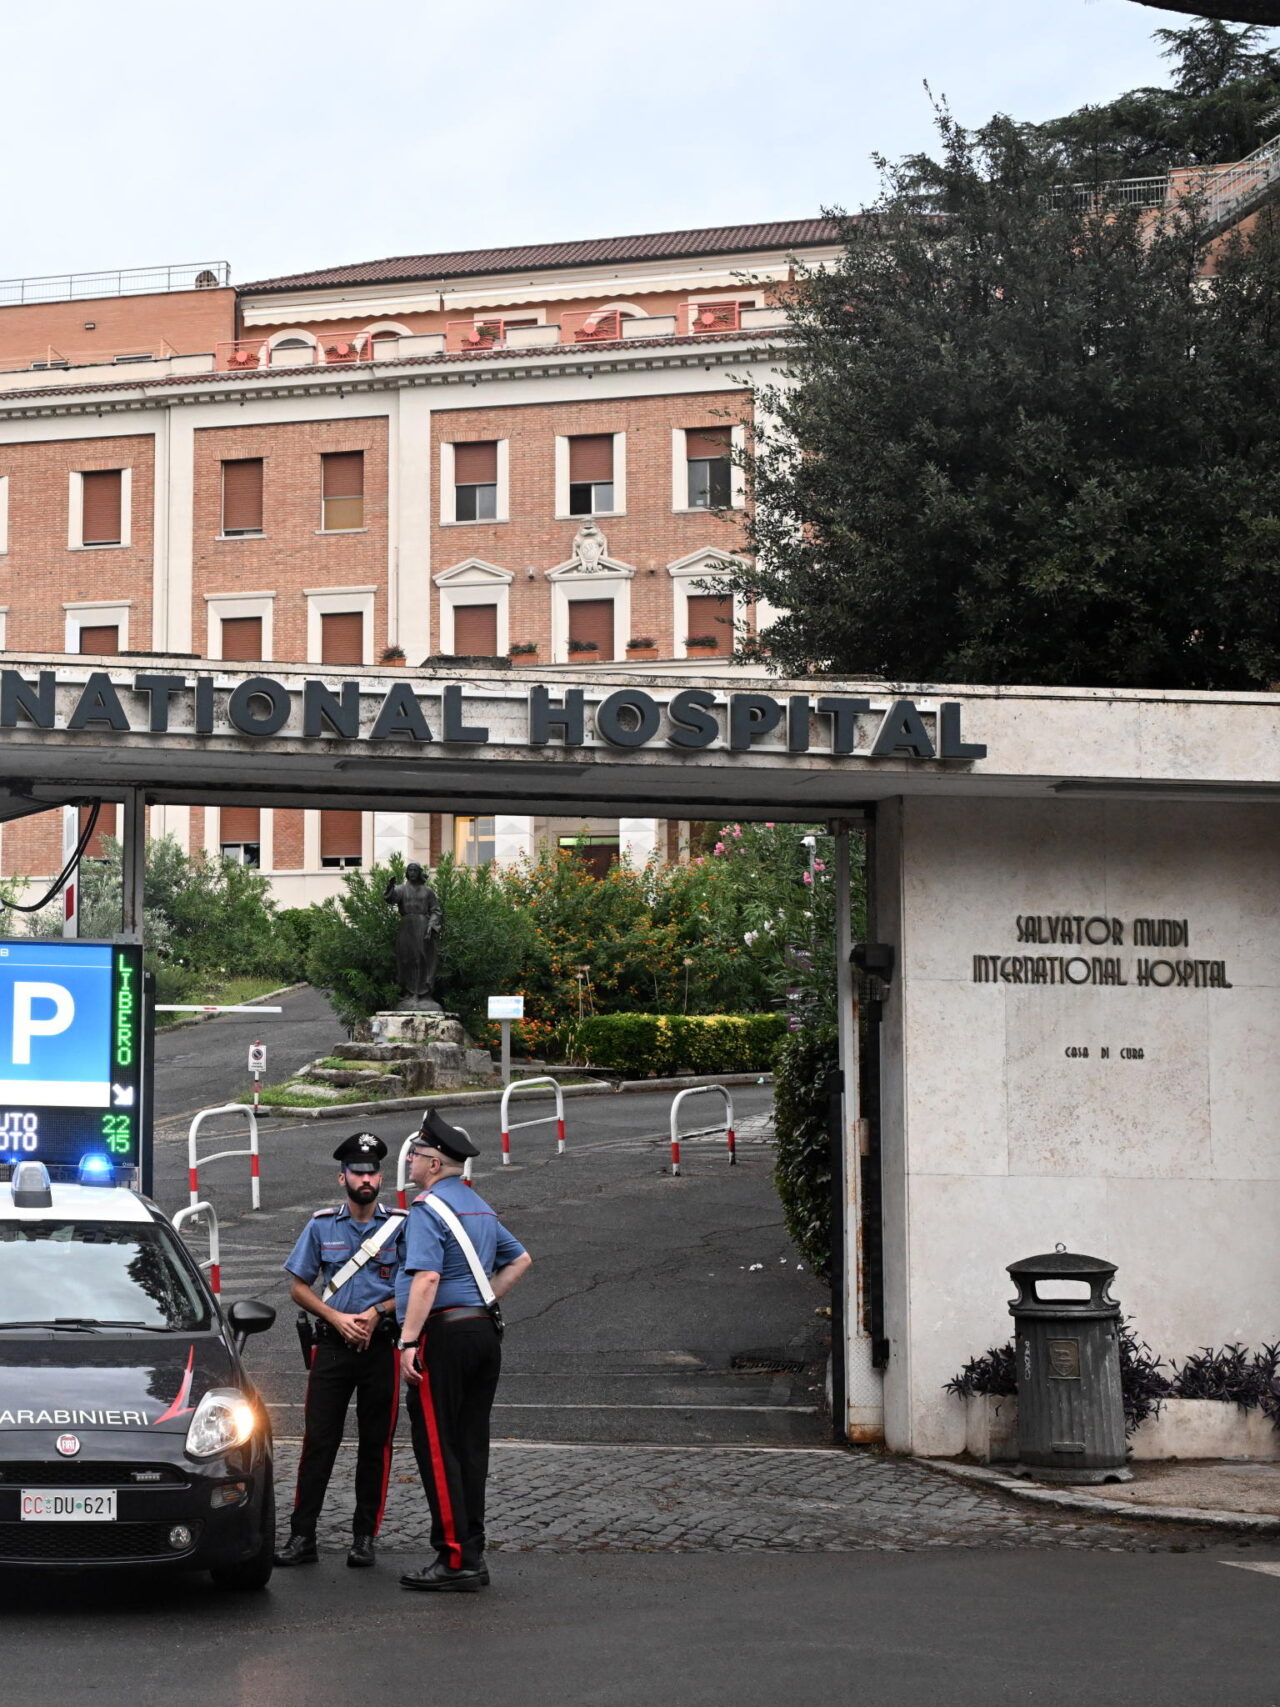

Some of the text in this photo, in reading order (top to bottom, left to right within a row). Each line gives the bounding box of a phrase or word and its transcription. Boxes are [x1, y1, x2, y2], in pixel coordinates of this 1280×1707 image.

[528, 684, 988, 761] HOSPITAL
[1016, 915, 1189, 948] SALVATOR MUNDI
[973, 955, 1233, 989] INTERNATIONAL HOSPITAL
[12, 981, 76, 1065] P
[117, 953, 133, 1066] LIBERO
[1064, 1047, 1145, 1060] CASA DI CURA
[102, 1115, 131, 1134] 22
[106, 1135, 131, 1154] 15
[23, 1496, 112, 1514] CC DU 621
